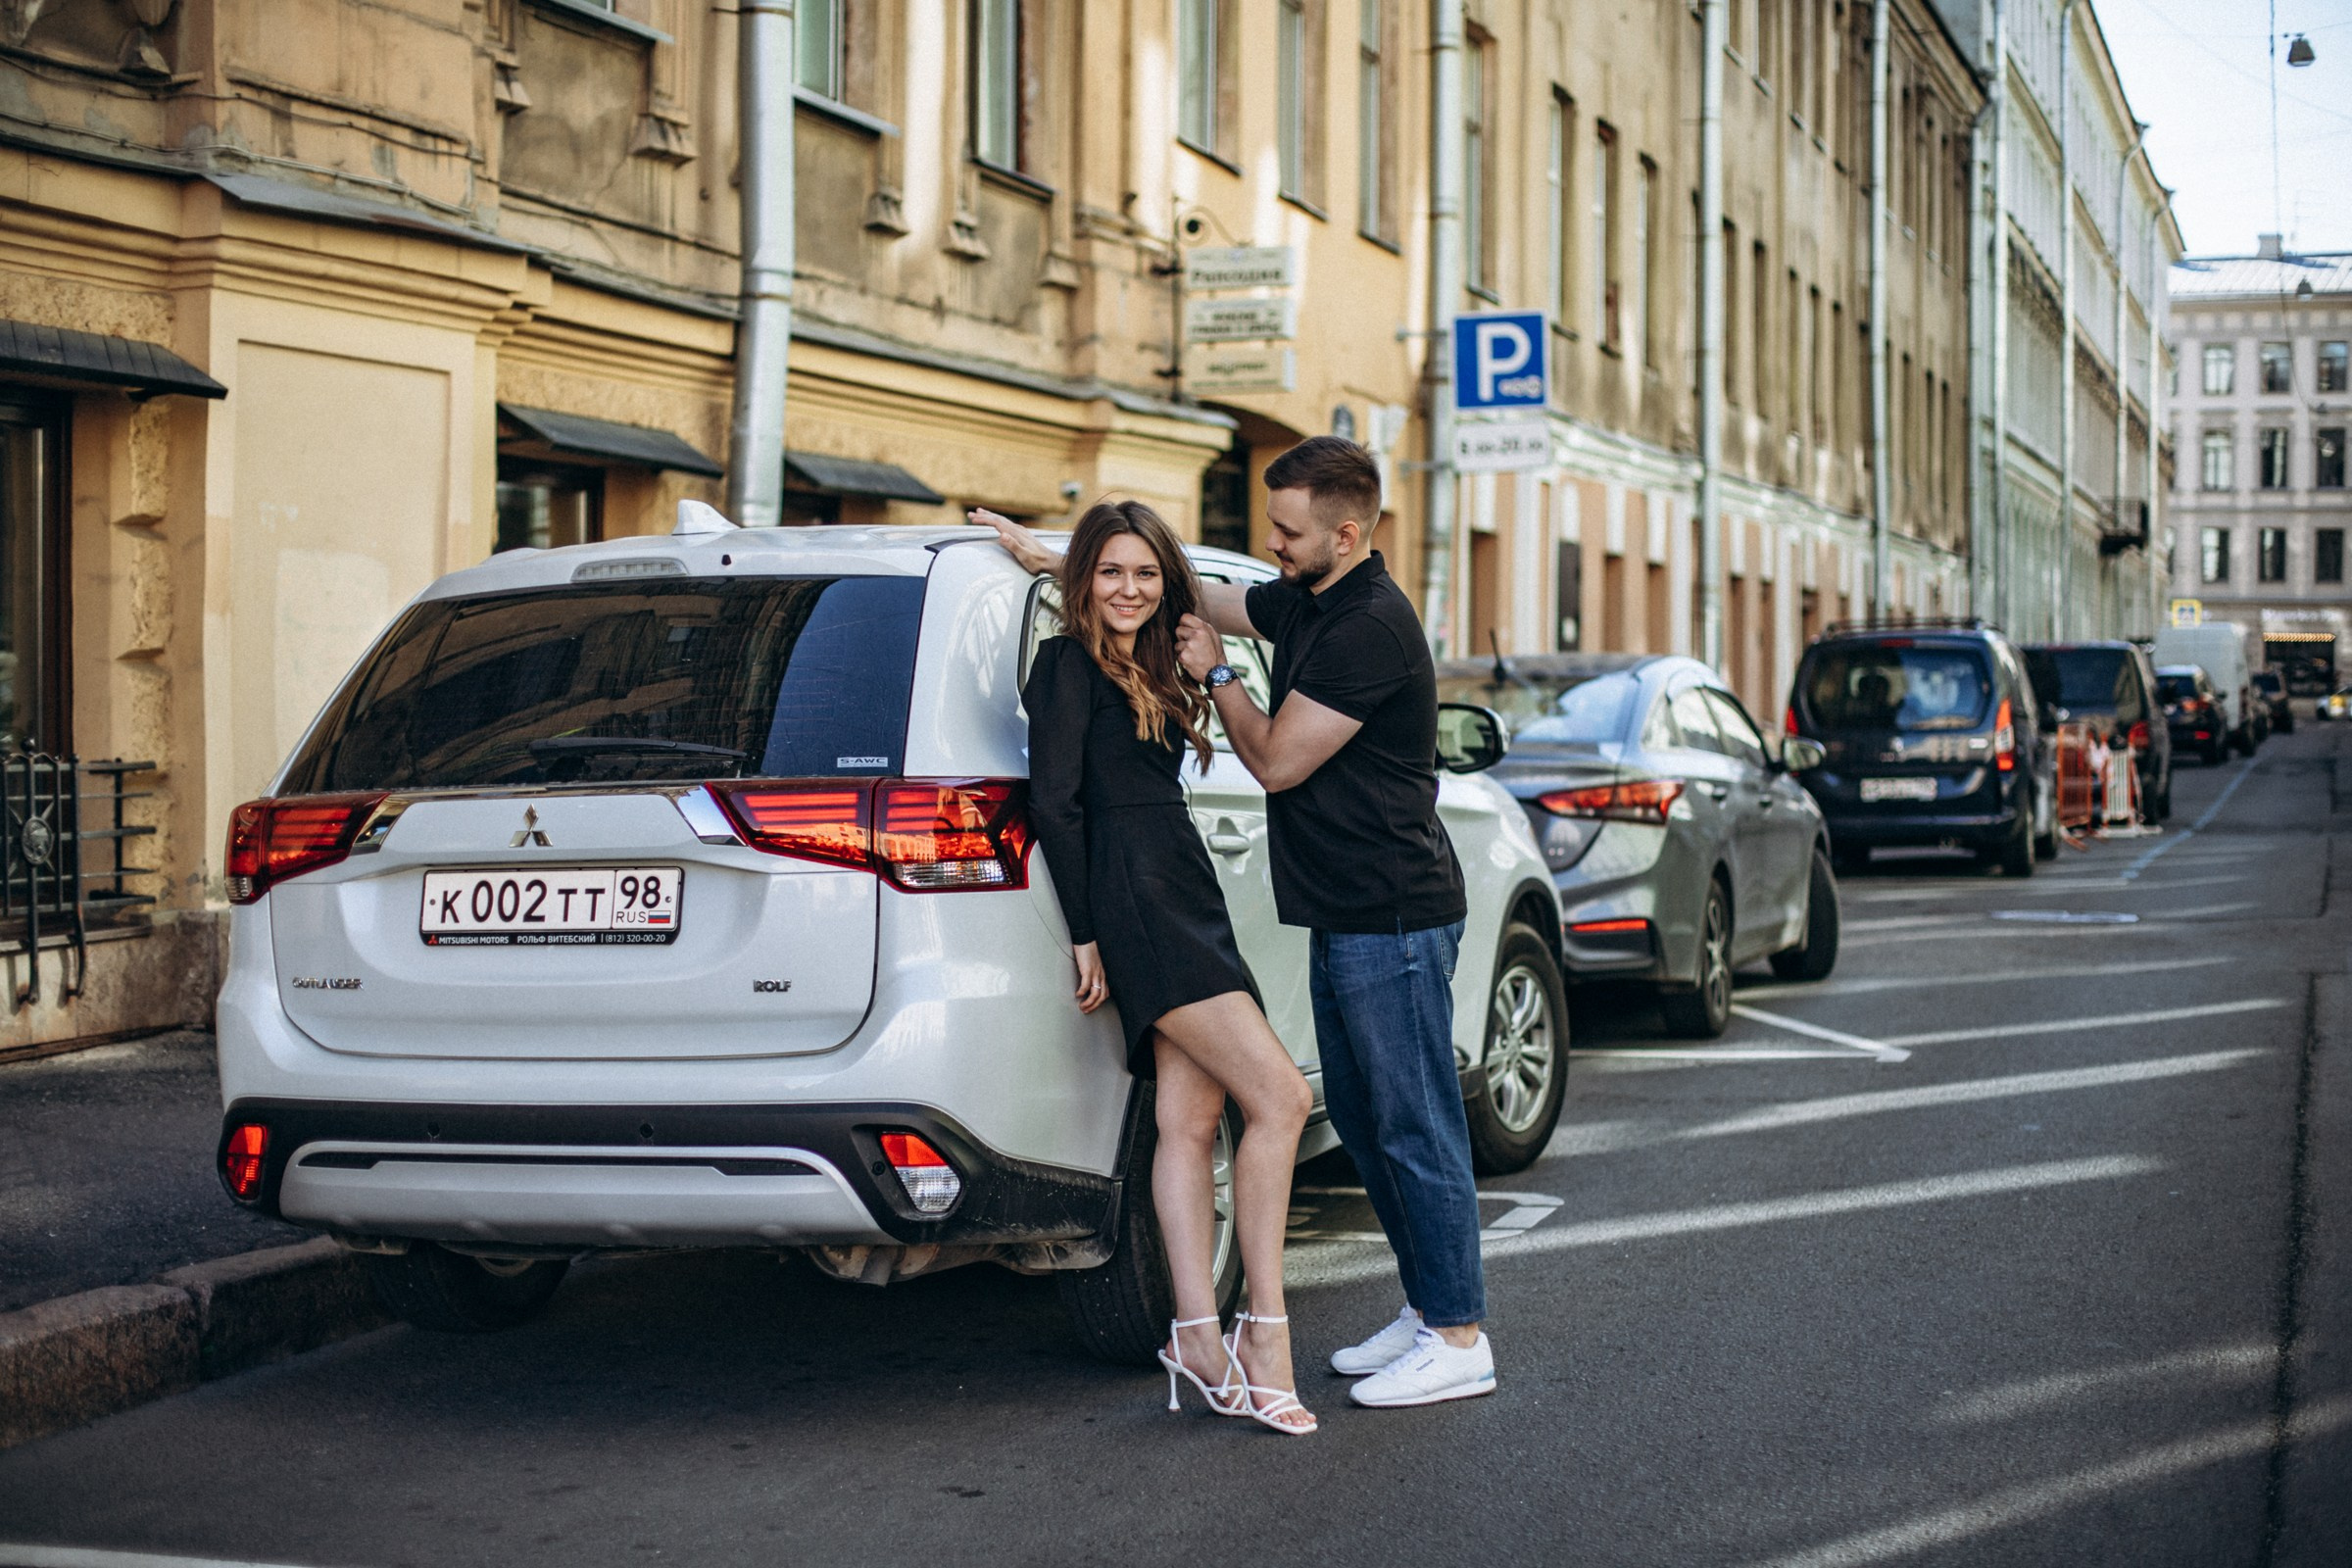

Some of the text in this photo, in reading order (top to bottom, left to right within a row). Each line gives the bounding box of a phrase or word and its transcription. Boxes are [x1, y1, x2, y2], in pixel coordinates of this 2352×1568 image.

[1476, 321, 1532, 402] P
[620, 875, 661, 908] 98
[615, 910, 647, 923] RUS
[438, 935, 510, 945] MITSUBISHI MOTORS
[516, 933, 666, 944] РОЛЬФ ВИТЕБСКИЙ (812) 320-00-20
[753, 979, 792, 993] ROLF
